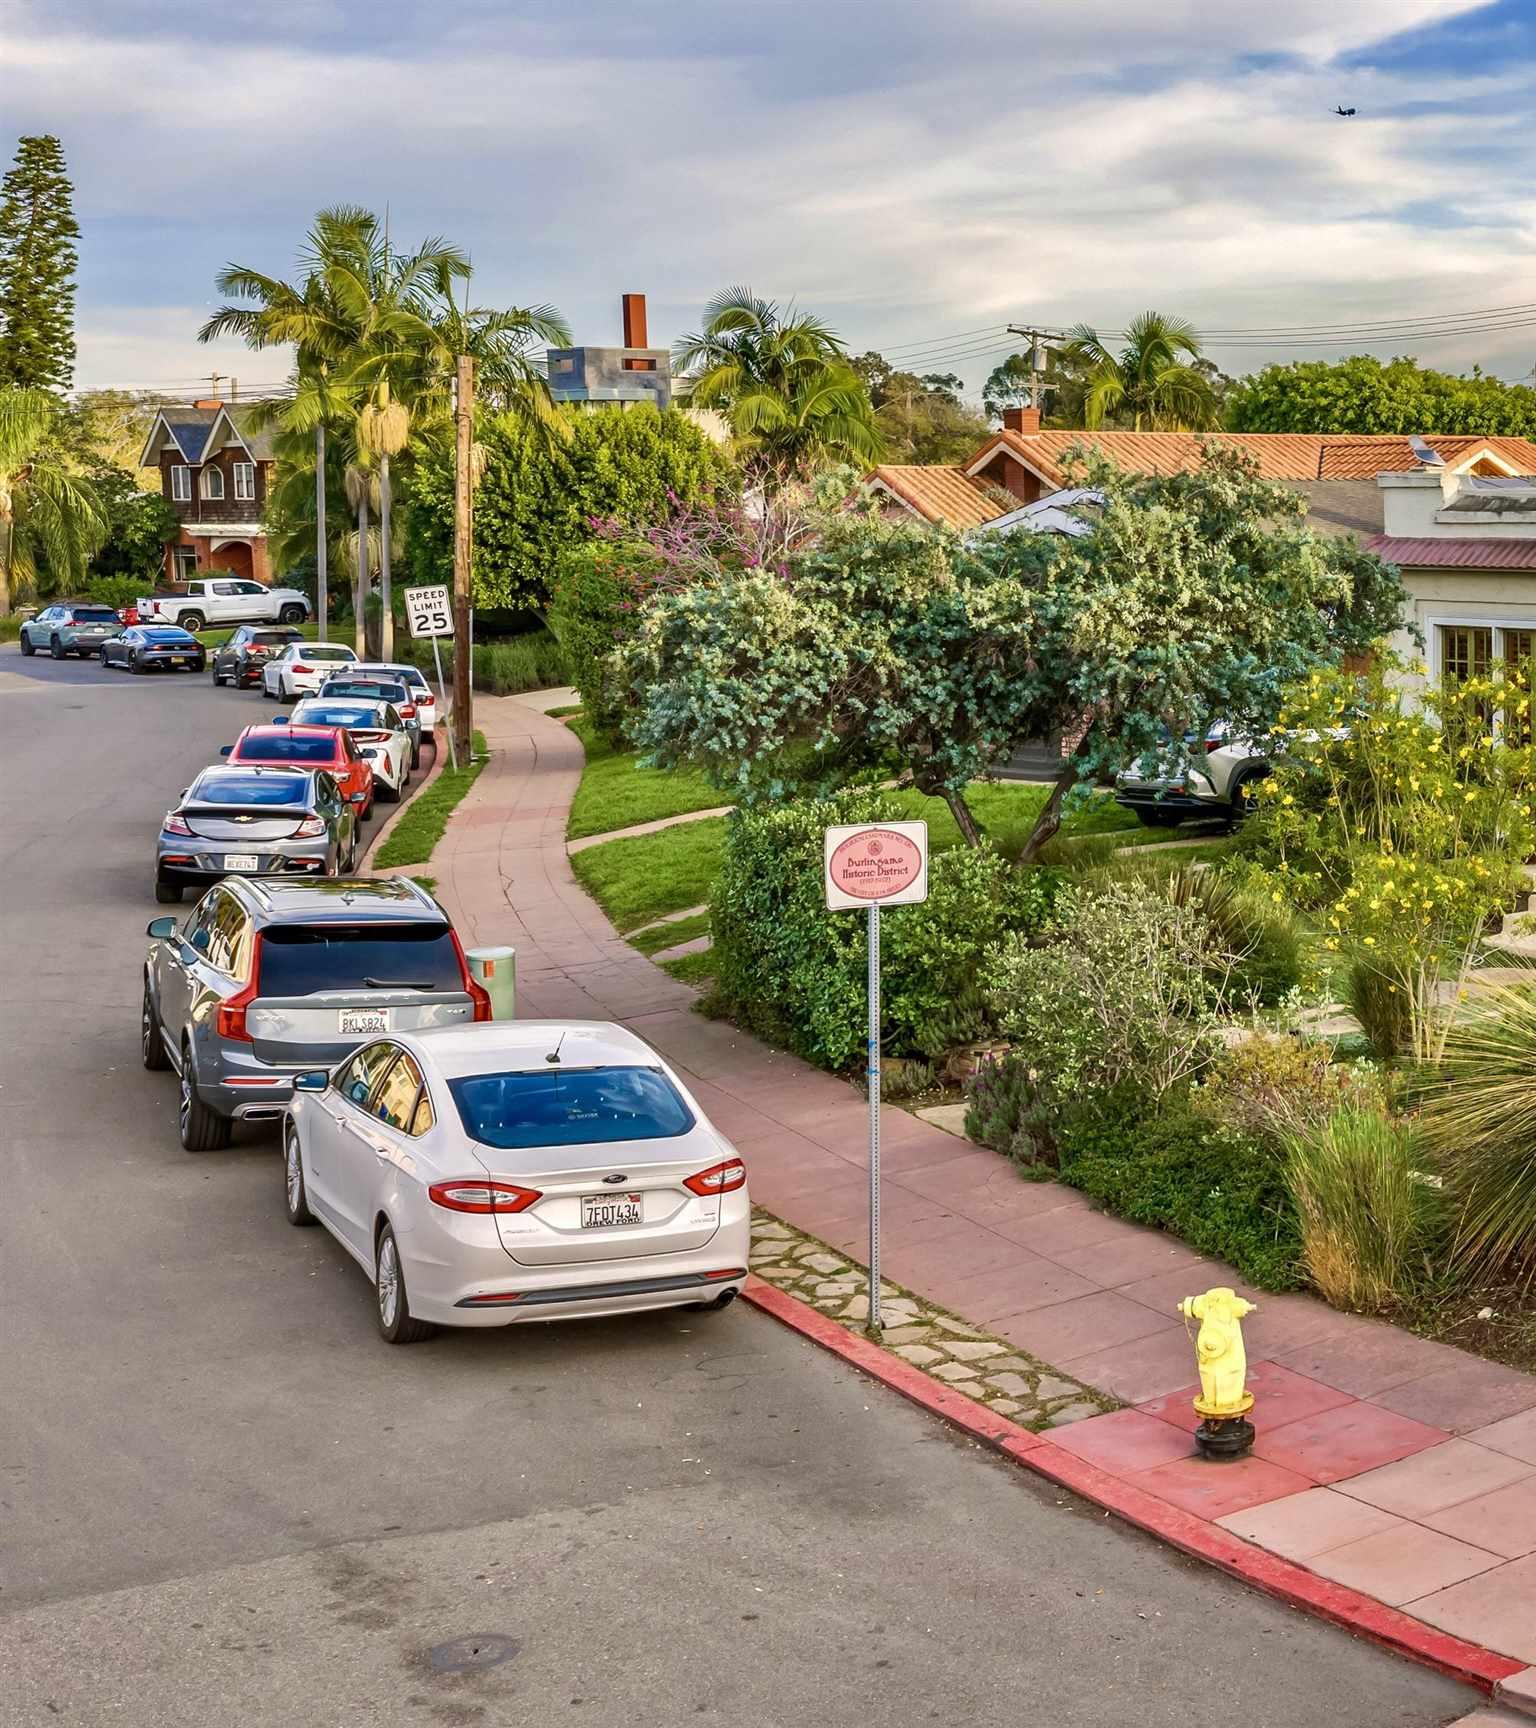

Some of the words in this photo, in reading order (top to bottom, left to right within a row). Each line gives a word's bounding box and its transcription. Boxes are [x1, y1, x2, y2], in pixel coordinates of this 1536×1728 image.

[409, 590, 445, 601] SPEED
[414, 601, 443, 611] LIMIT
[415, 612, 447, 631] 25
[843, 868, 876, 879] Historic
[877, 866, 908, 876] District
